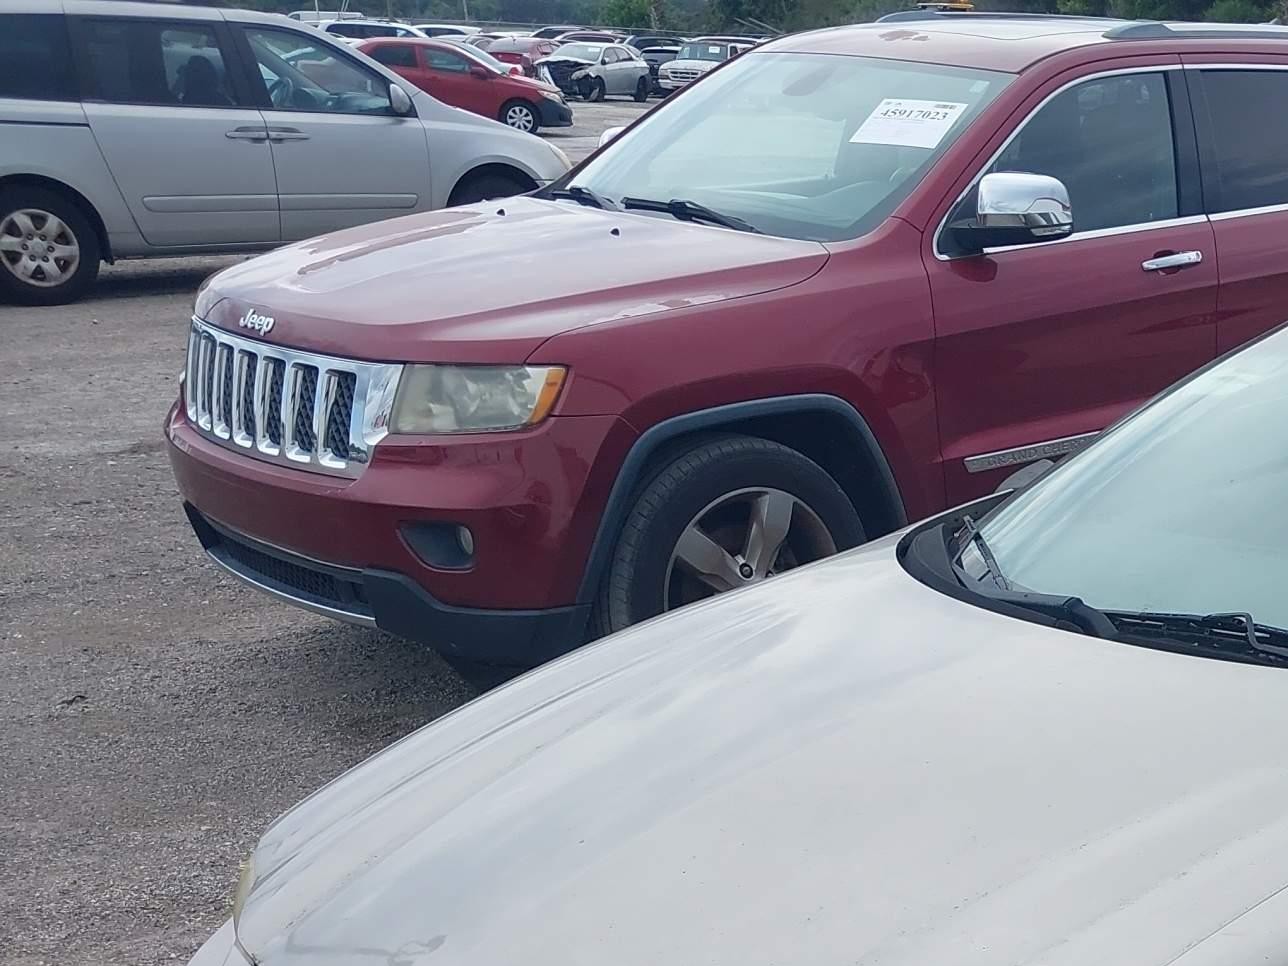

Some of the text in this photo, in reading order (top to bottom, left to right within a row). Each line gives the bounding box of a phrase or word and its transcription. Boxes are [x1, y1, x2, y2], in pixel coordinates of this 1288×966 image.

[880, 108, 949, 121] 45917023
[239, 308, 275, 337] Jeep
[986, 448, 1039, 467] GRAND
